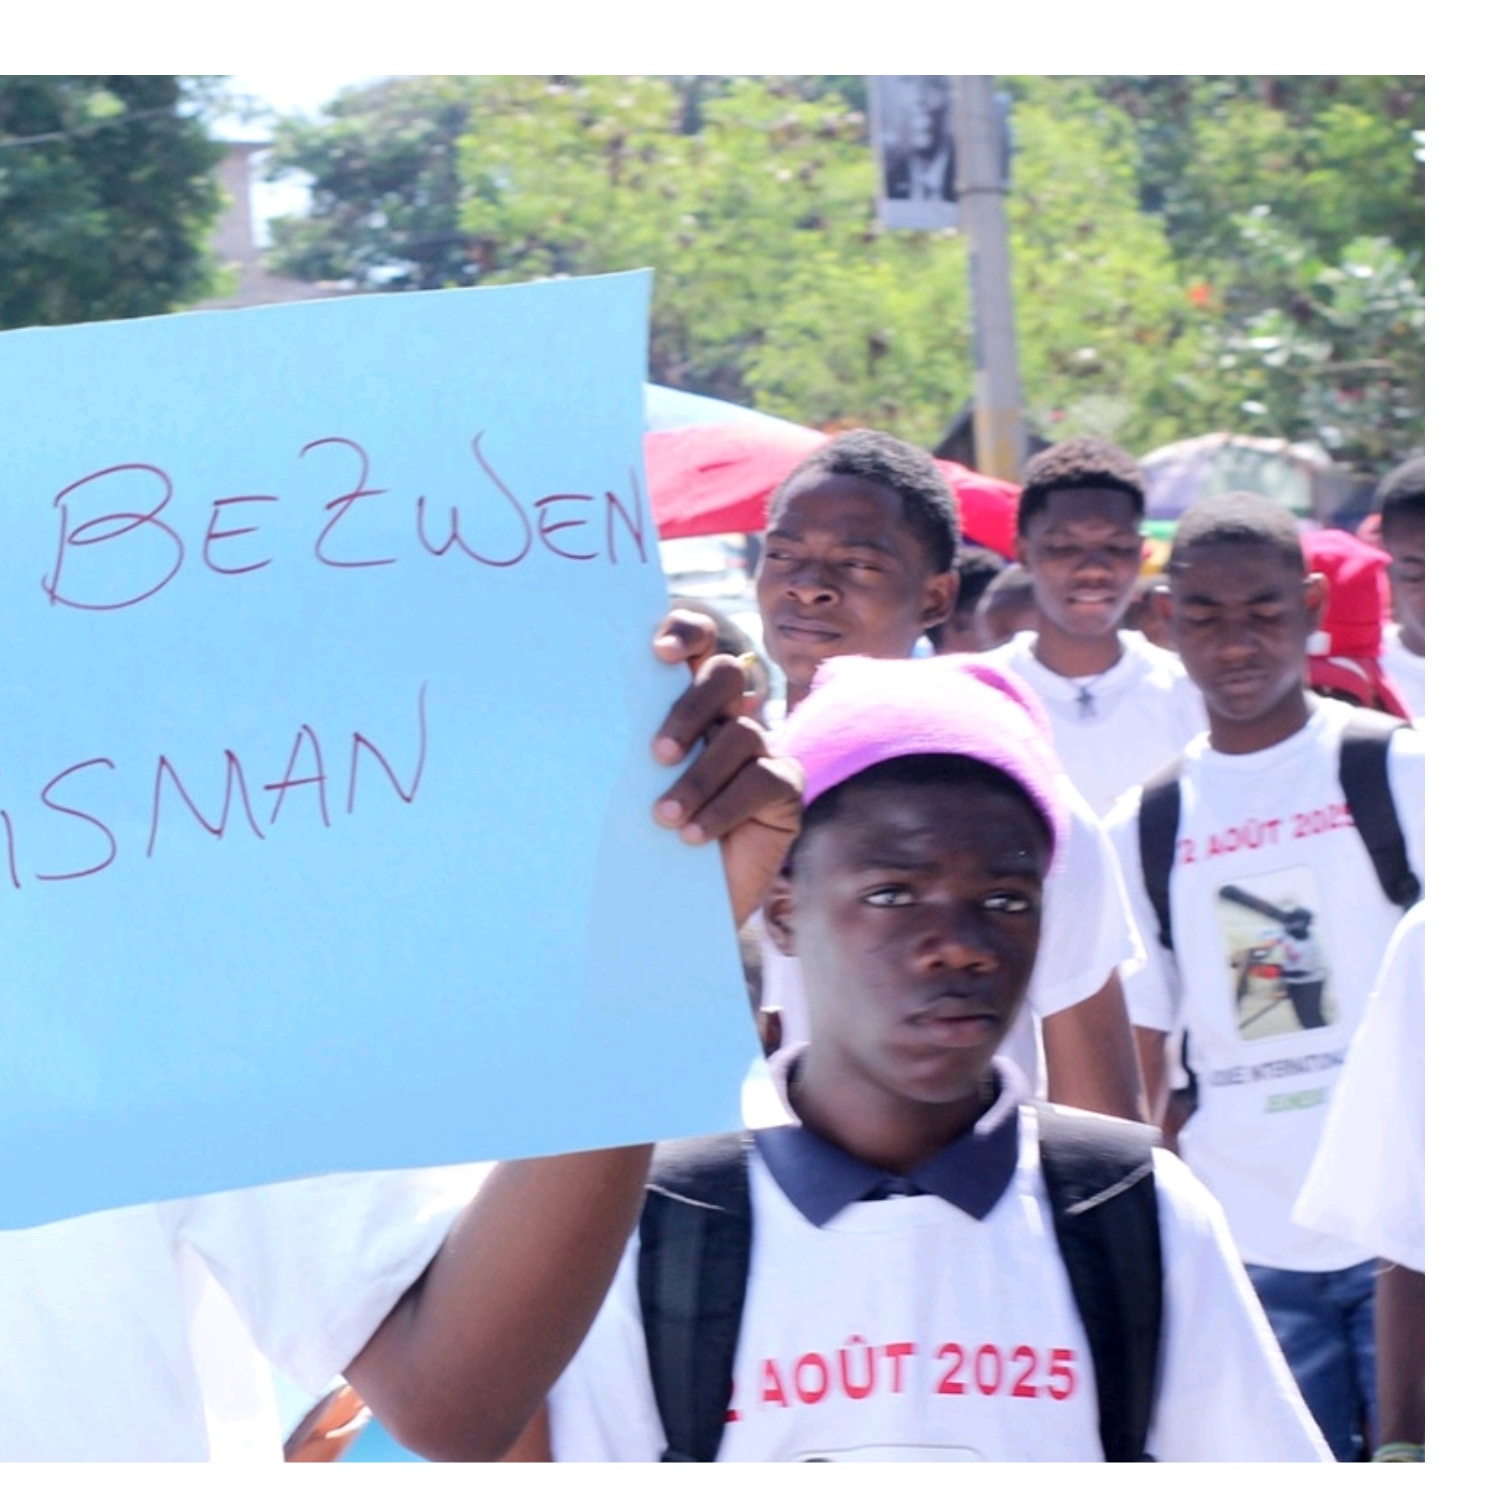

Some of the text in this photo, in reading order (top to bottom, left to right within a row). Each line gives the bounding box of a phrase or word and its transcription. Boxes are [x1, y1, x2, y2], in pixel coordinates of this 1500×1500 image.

[40, 432, 650, 610] BEZWEN
[757, 1334, 916, 1411] AOÛT
[937, 1340, 1080, 1402] 2025
